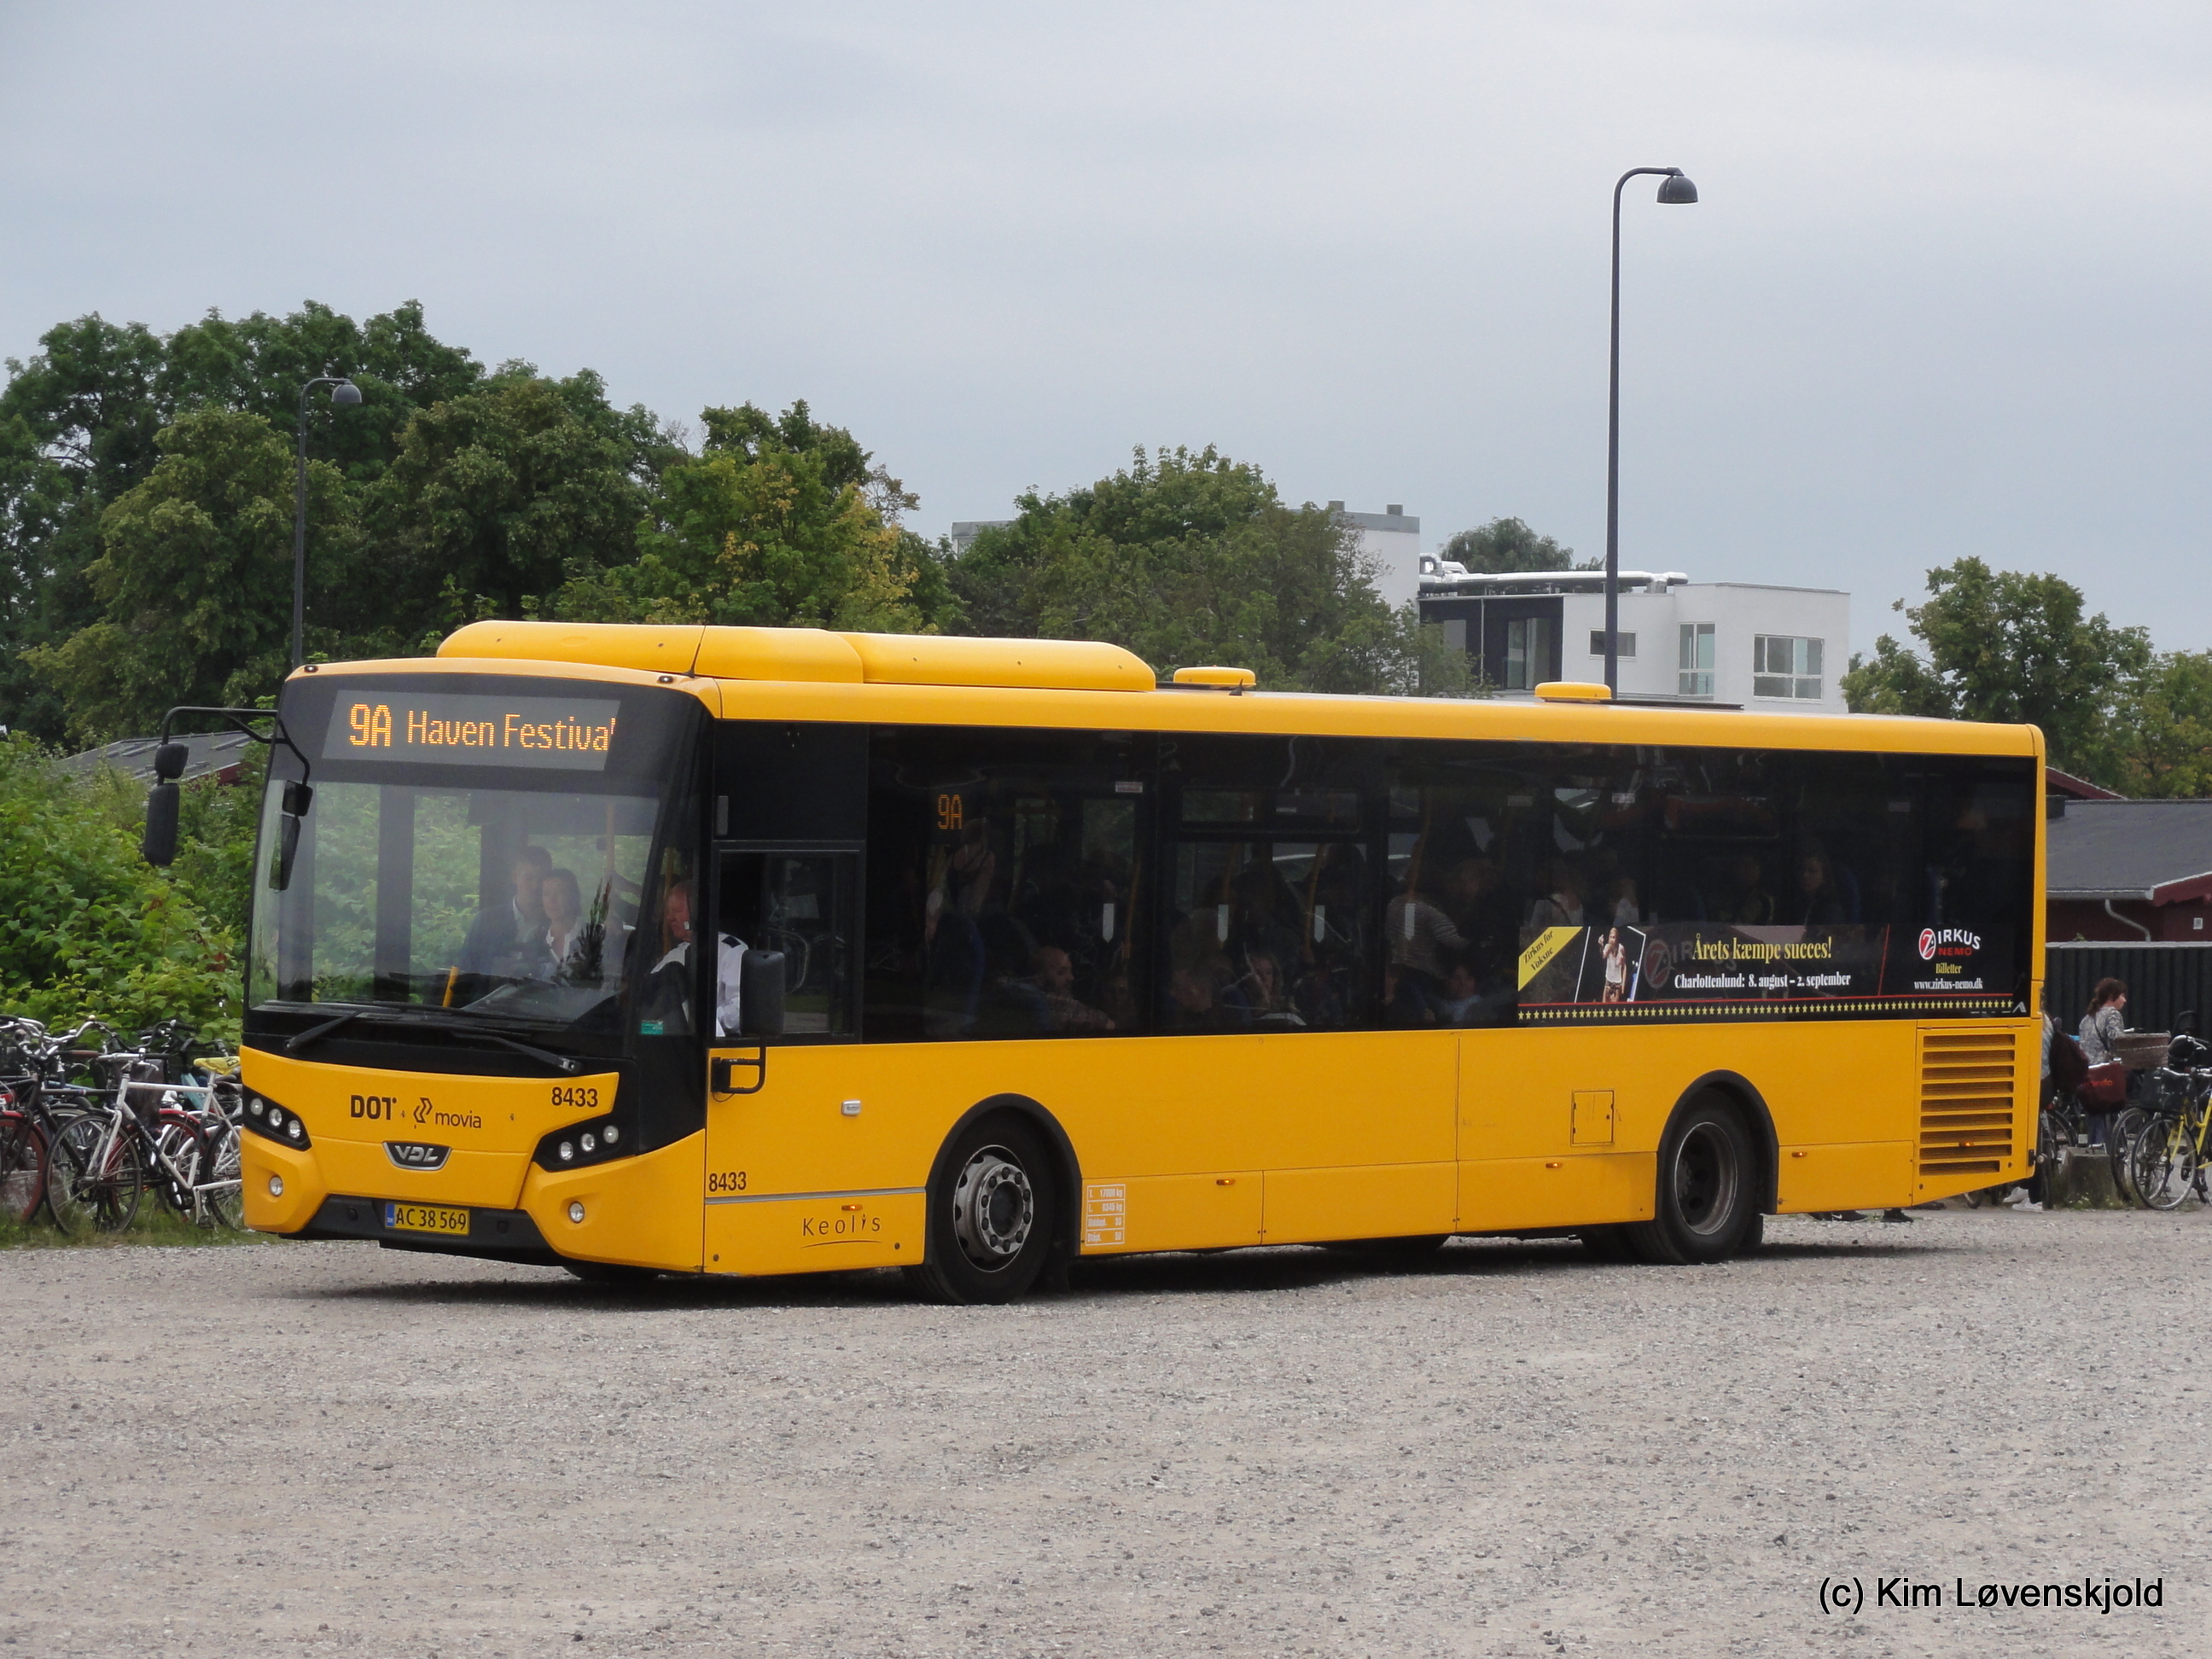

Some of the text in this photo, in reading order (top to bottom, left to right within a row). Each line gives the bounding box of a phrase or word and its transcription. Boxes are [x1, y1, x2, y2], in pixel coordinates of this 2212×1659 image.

[350, 704, 391, 747] 9A
[407, 710, 494, 746] Haven
[938, 794, 963, 830] 9A
[1523, 930, 1553, 964] Zirkus for
[1691, 933, 1832, 964] Årets kæmpe succes!
[1938, 946, 1973, 957] NEMO
[1530, 947, 1553, 971] Voksne
[1936, 962, 1962, 974] Billetter
[1674, 973, 1745, 988] Charlottenlund:
[1749, 974, 1757, 987] 8.
[1759, 974, 1788, 990] august
[1796, 976, 1805, 987] 2.
[1806, 971, 1851, 988] september
[1914, 978, 1983, 990] www.zirkus-nemo.dk
[351, 1095, 397, 1121] DOT
[551, 1086, 598, 1108] 8433
[435, 1110, 482, 1128] movia
[394, 1144, 439, 1162] VDL
[708, 1171, 747, 1192] 8433
[396, 1208, 467, 1231] AC 38 569
[802, 1214, 881, 1237] Keolis
